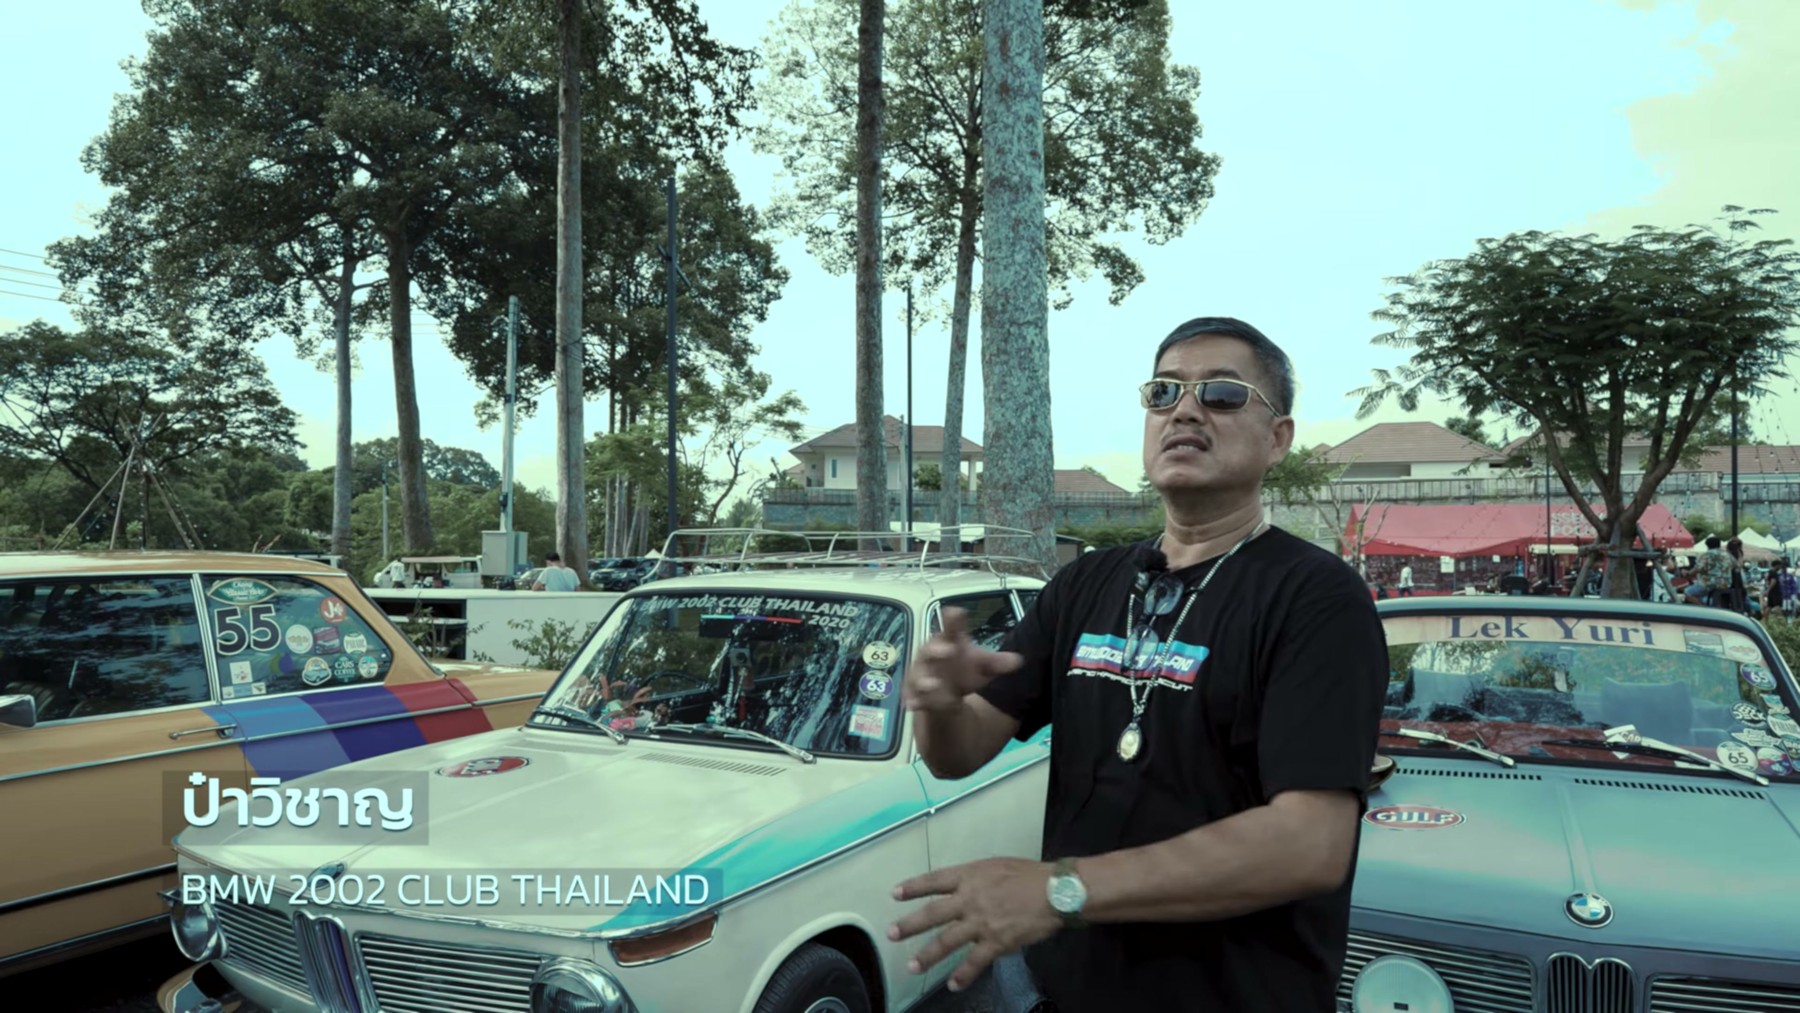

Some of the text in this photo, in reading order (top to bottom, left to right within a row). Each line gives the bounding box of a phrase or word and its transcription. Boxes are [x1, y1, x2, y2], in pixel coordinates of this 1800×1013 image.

[679, 595, 714, 609] 2002
[718, 596, 761, 609] CLUB
[765, 599, 858, 617] THAILAND
[808, 615, 849, 629] 2020
[214, 604, 281, 655] 55
[1448, 616, 1656, 645] Lek Yuri
[871, 651, 888, 661] 63
[1750, 671, 1768, 683] 65
[867, 680, 886, 692] 63
[1728, 752, 1748, 764] 65
[1375, 810, 1456, 825] GULF
